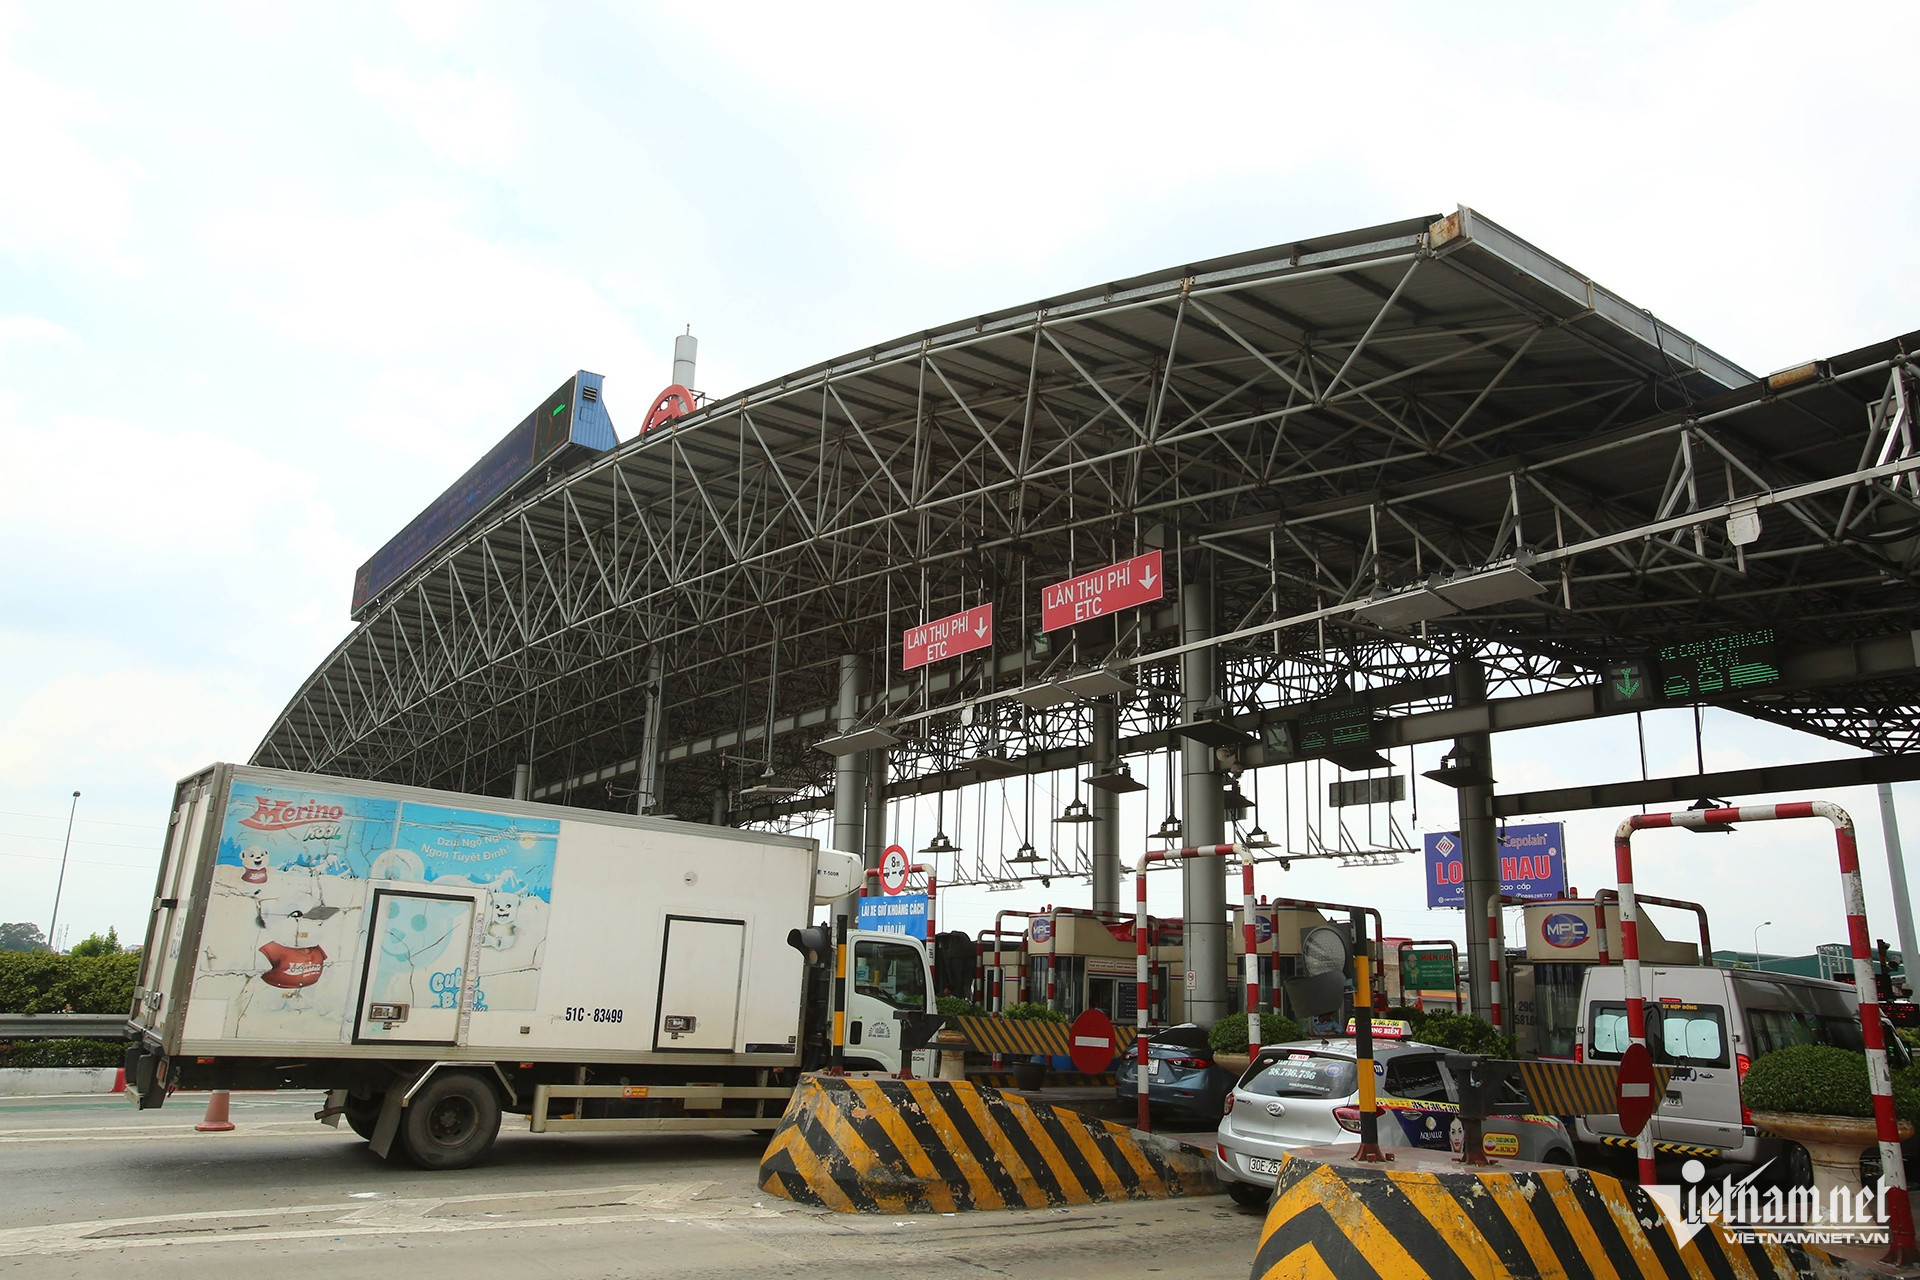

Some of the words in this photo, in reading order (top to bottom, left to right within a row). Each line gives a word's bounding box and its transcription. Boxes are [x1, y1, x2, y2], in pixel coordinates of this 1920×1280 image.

[1048, 584, 1074, 610] LÀN
[1077, 575, 1104, 600] THU
[1108, 560, 1131, 591] PHÍ
[1075, 597, 1103, 621] ETC
[908, 628, 927, 650] LÀN
[929, 622, 949, 642] THU
[952, 610, 969, 636] PHÍ
[927, 641, 948, 661] ETC
[246, 796, 344, 827] Merino
[421, 844, 449, 858] Ngon
[1436, 860, 1463, 885] LO
[909, 899, 925, 915] CÁCH
[1547, 923, 1584, 935] MPC
[565, 1007, 585, 1022] 51C
[593, 1008, 623, 1023] 83499
